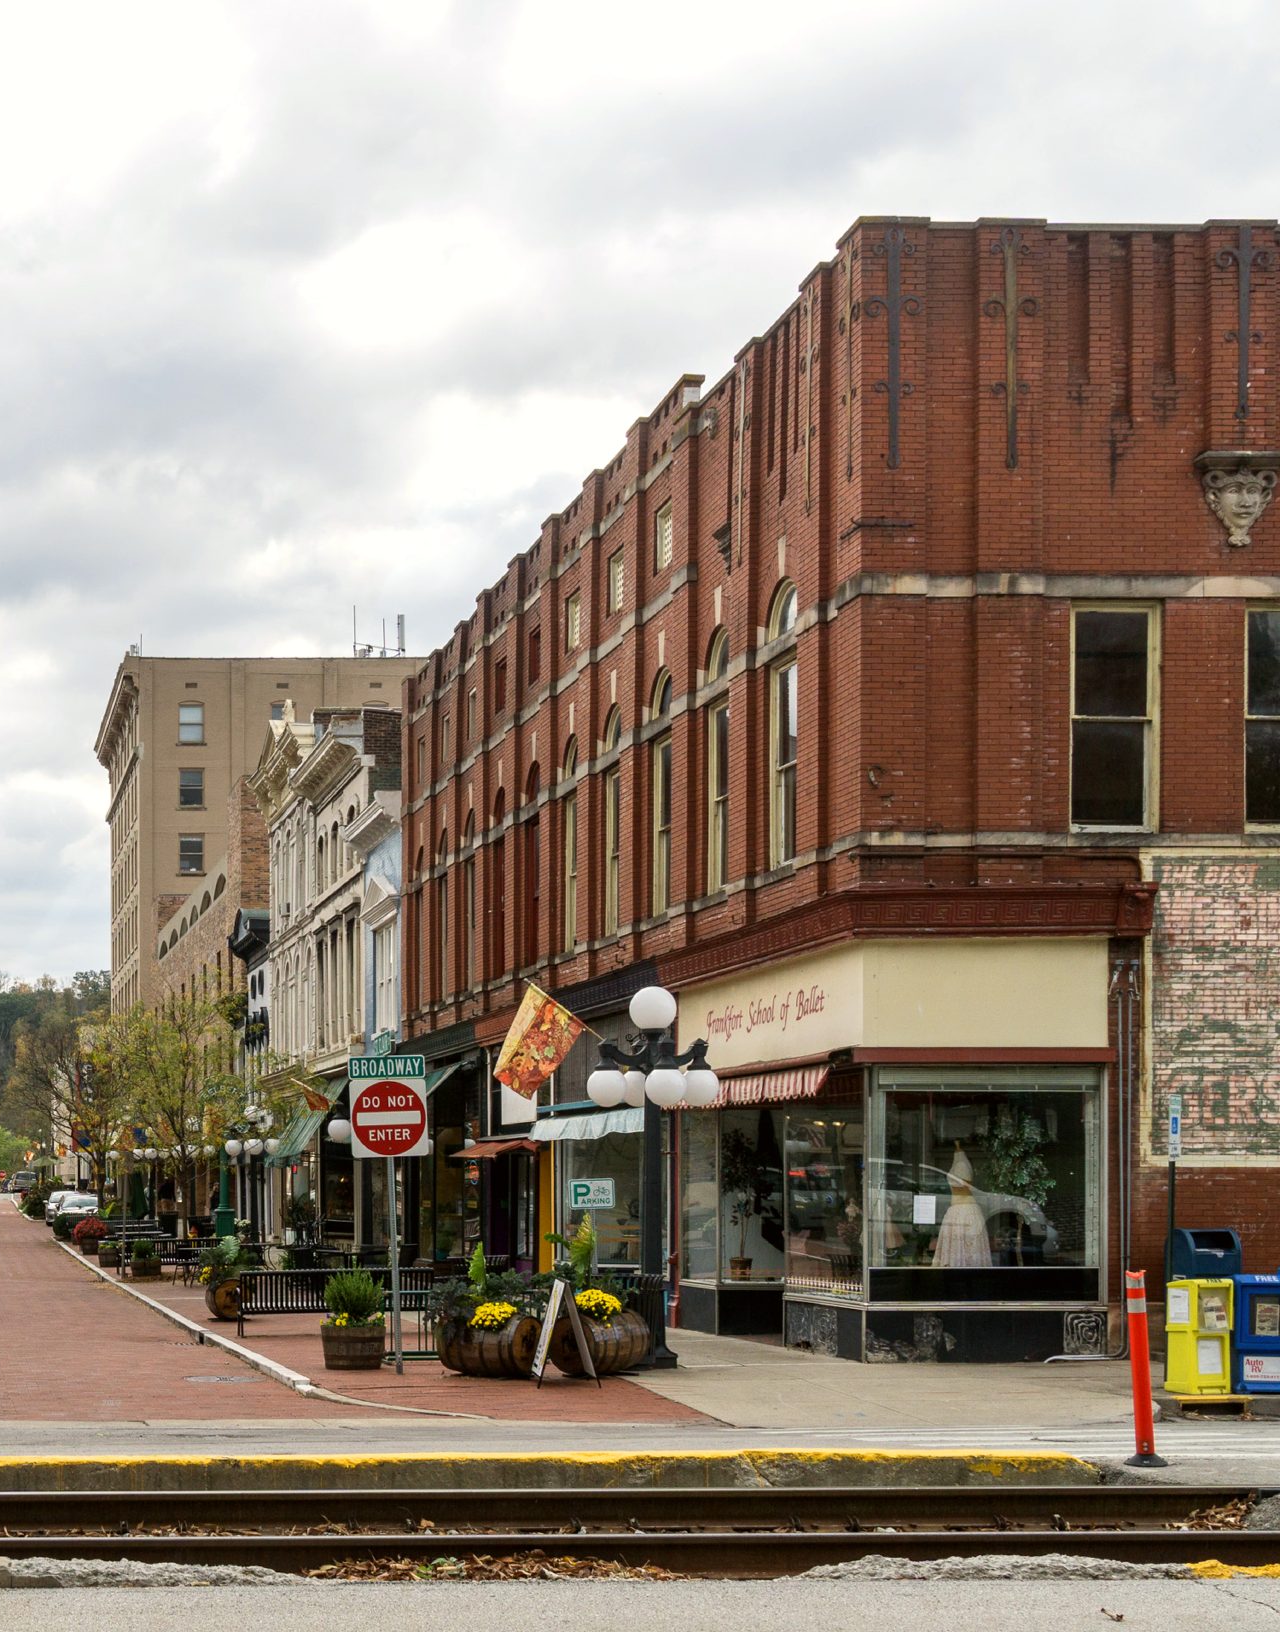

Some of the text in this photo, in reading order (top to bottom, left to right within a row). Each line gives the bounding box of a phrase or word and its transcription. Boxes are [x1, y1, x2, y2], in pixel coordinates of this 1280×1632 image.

[705, 984, 825, 1042] Frankfort School of Ballet
[352, 1058, 421, 1076] BROADWAY
[362, 1094, 415, 1109] DO NOT
[368, 1128, 411, 1142] ENTER
[1254, 1274, 1280, 1282] FREE
[1245, 1358, 1264, 1366] Auto
[1251, 1365, 1262, 1373] RV
